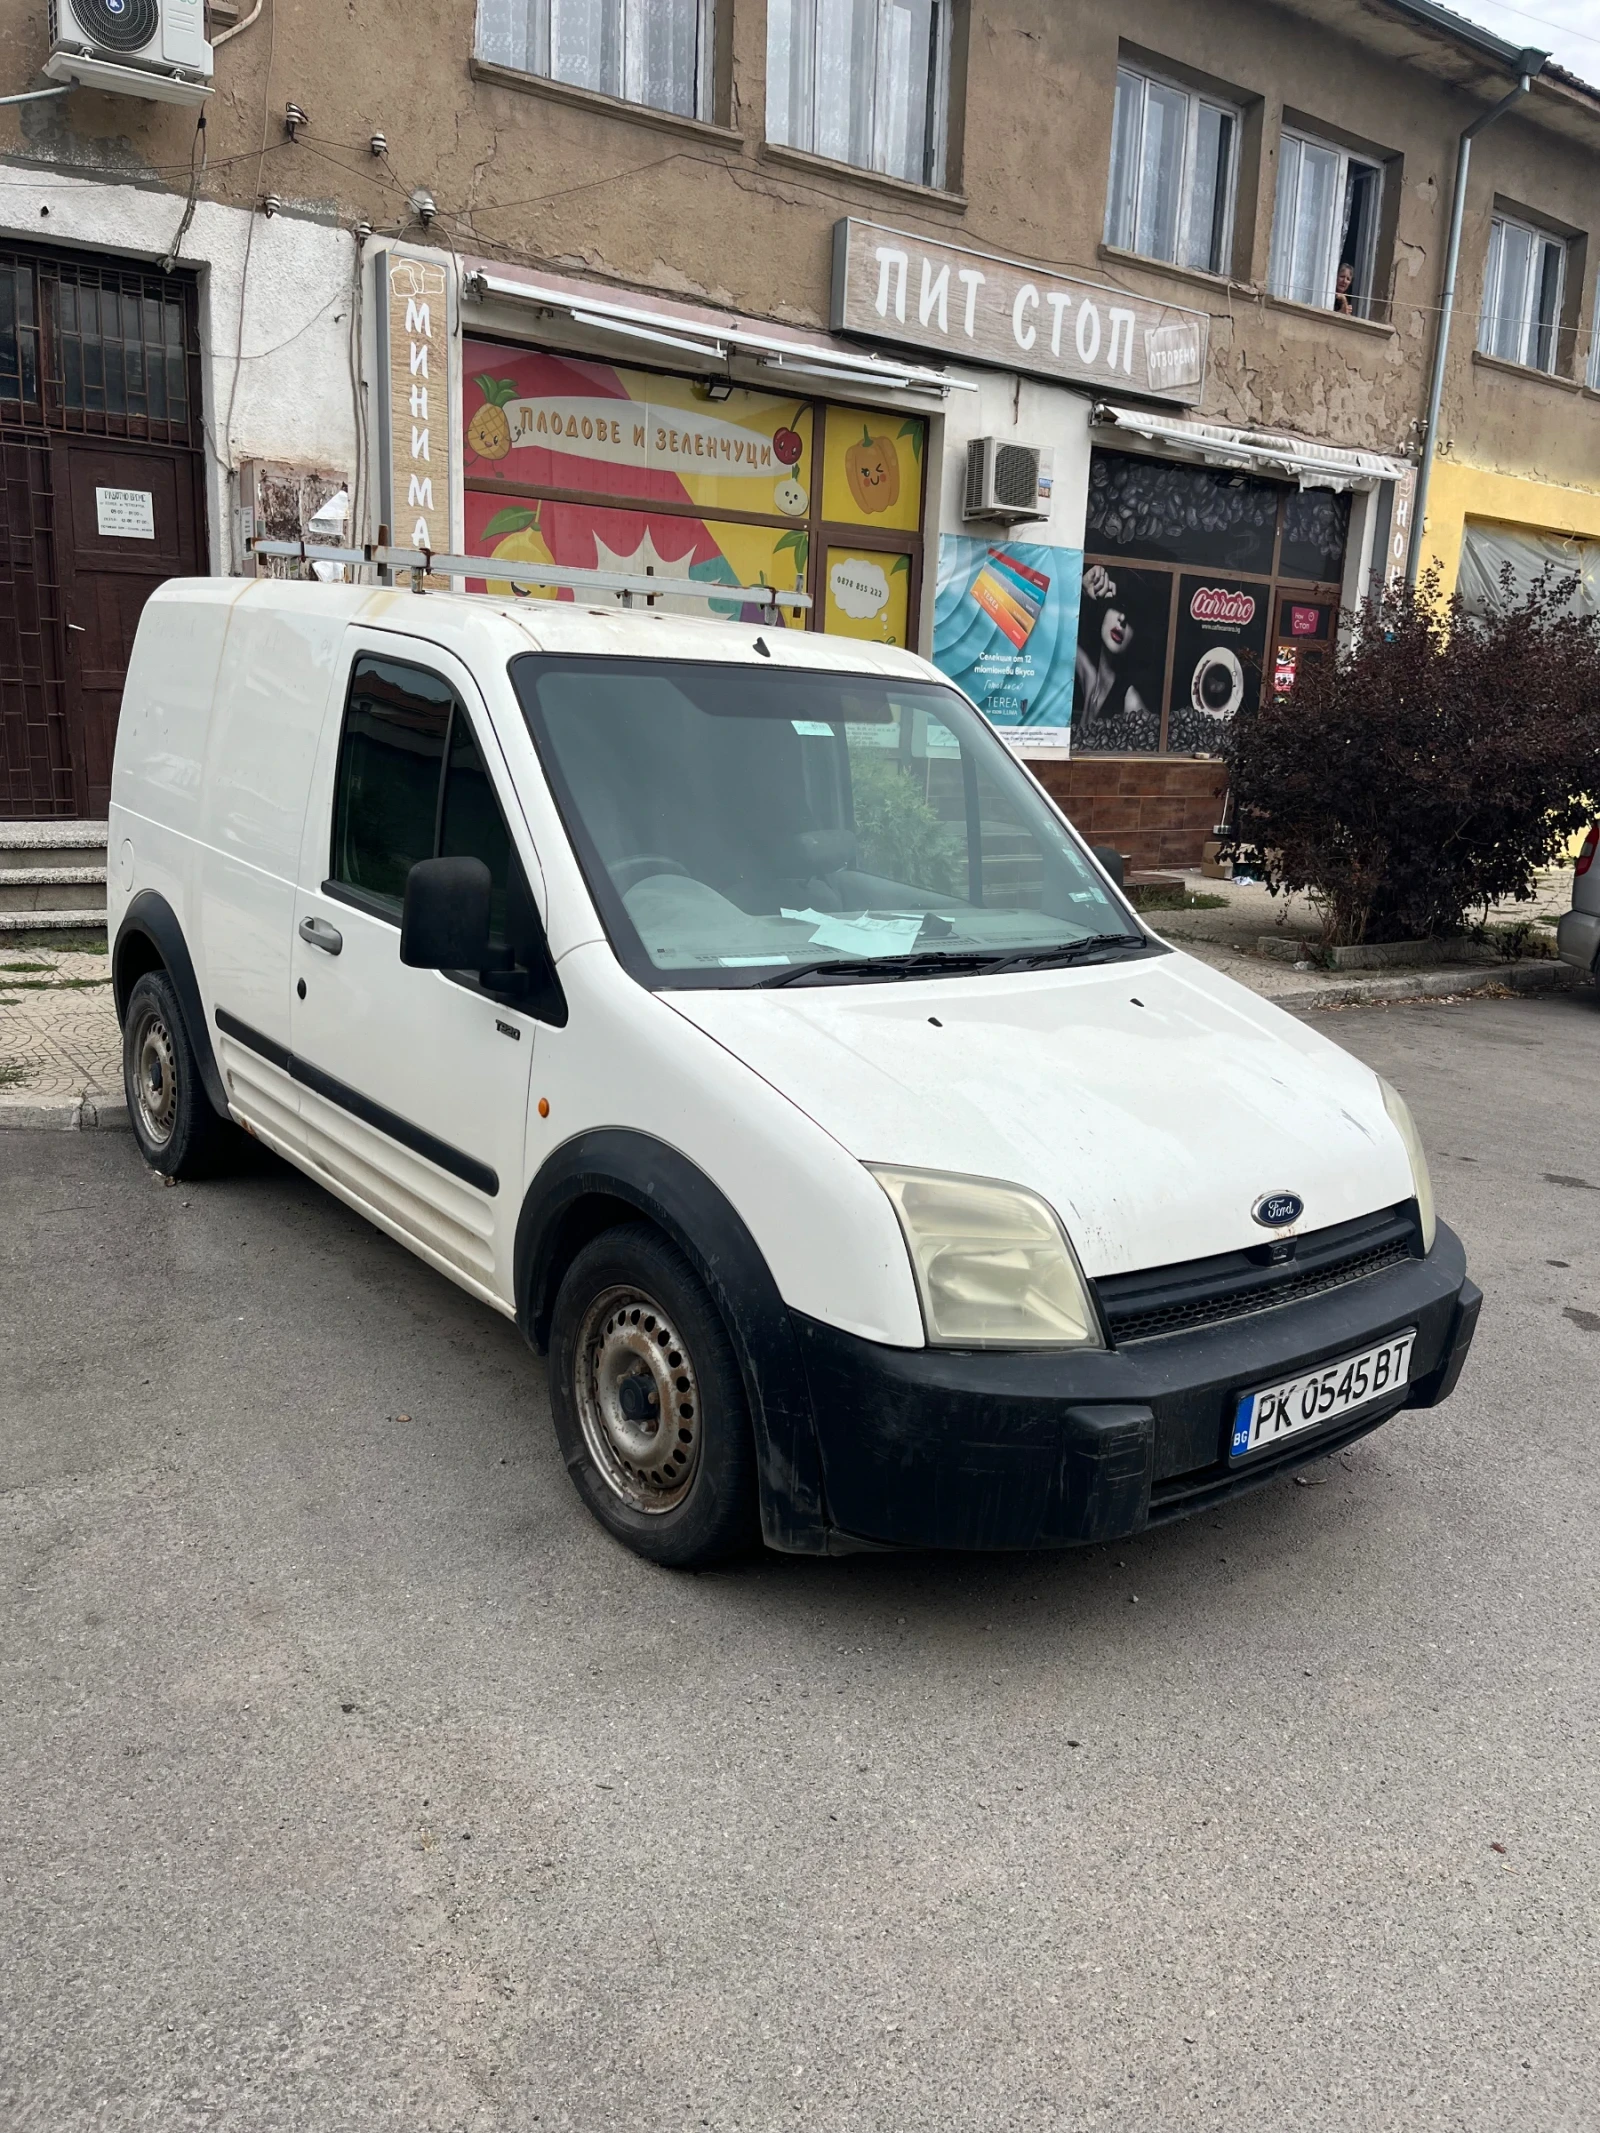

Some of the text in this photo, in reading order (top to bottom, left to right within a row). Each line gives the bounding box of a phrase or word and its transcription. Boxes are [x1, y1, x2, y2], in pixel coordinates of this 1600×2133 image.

[875, 247, 1136, 375] ПИТ СТОП
[1149, 346, 1196, 369] ОТВОРЕНО
[519, 406, 773, 467] ПЛОДОВЕ И ЗЕЛЕНЧУЦИ
[837, 576, 882, 597] 0878 855 222
[1194, 593, 1253, 619] Carraro
[1294, 621, 1310, 630] Стоп
[979, 652, 1012, 662] Селекция
[1025, 655, 1032, 663] 12
[1015, 667, 1035, 678] вкуса
[988, 696, 1018, 708] TEREA
[1267, 1199, 1294, 1219] Ford
[1301, 1357, 1371, 1420] 0545
[1373, 1340, 1409, 1391] BT
[1233, 1430, 1248, 1446] BG
